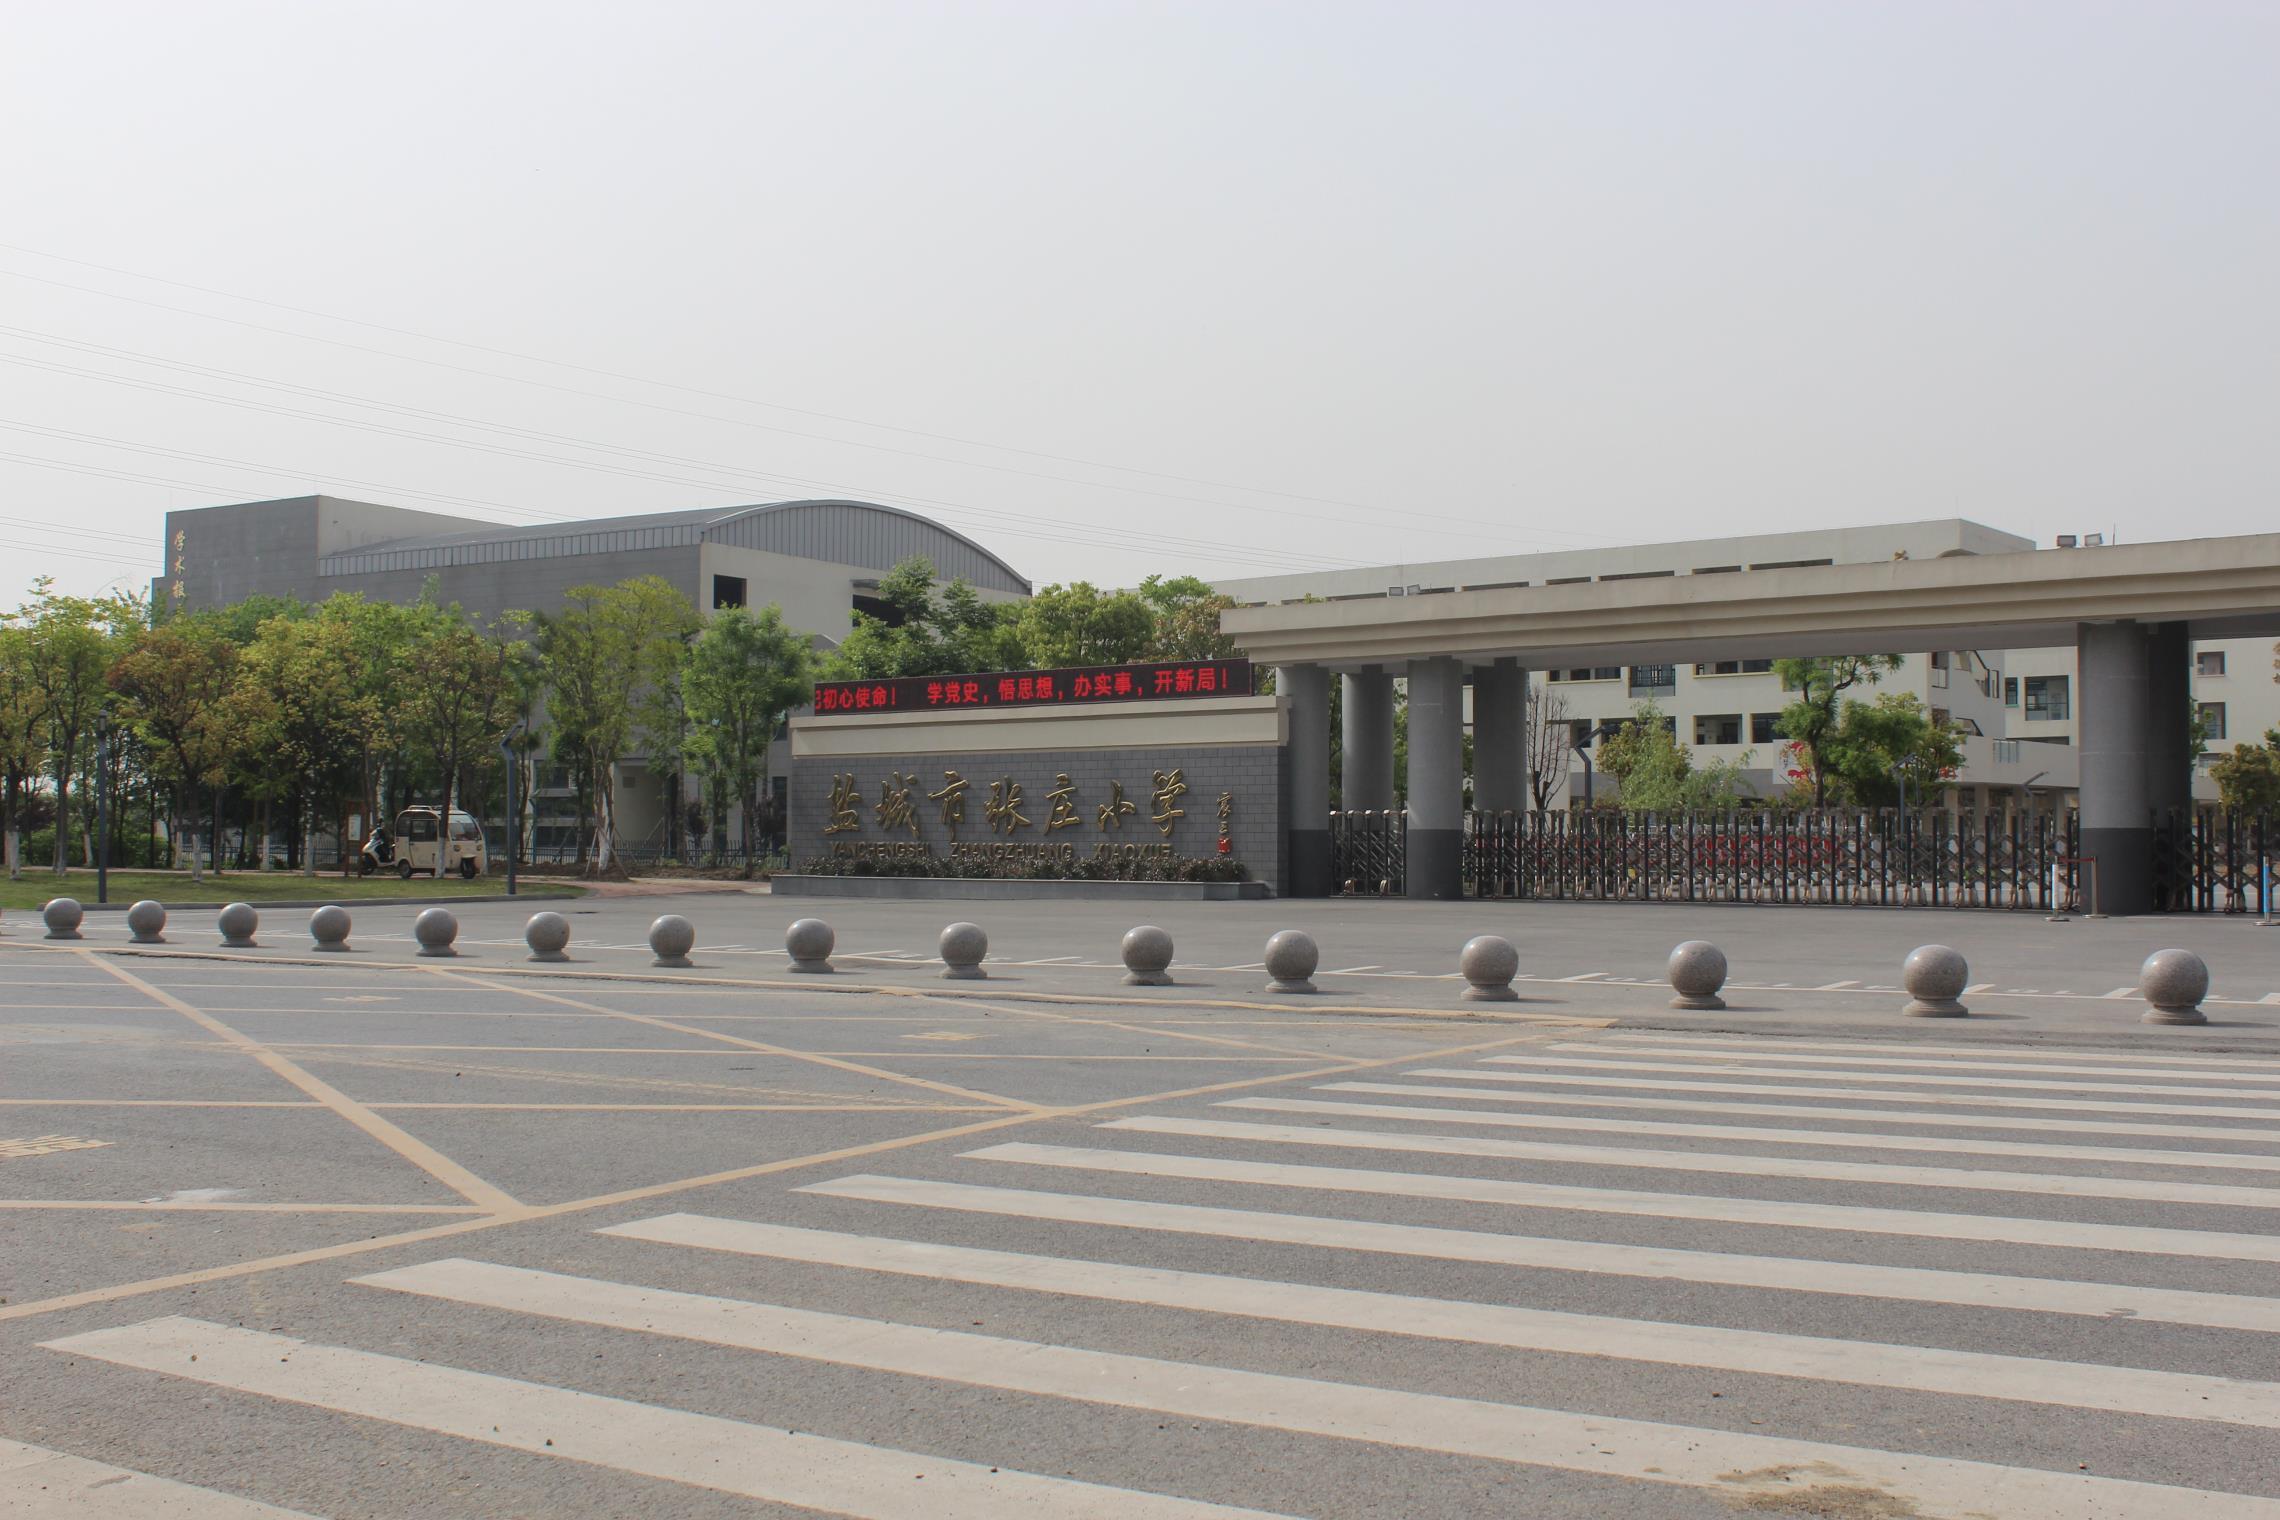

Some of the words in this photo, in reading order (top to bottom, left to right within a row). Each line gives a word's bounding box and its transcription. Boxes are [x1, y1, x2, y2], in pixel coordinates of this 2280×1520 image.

[824, 769, 1187, 842] 盐城市张庄小学
